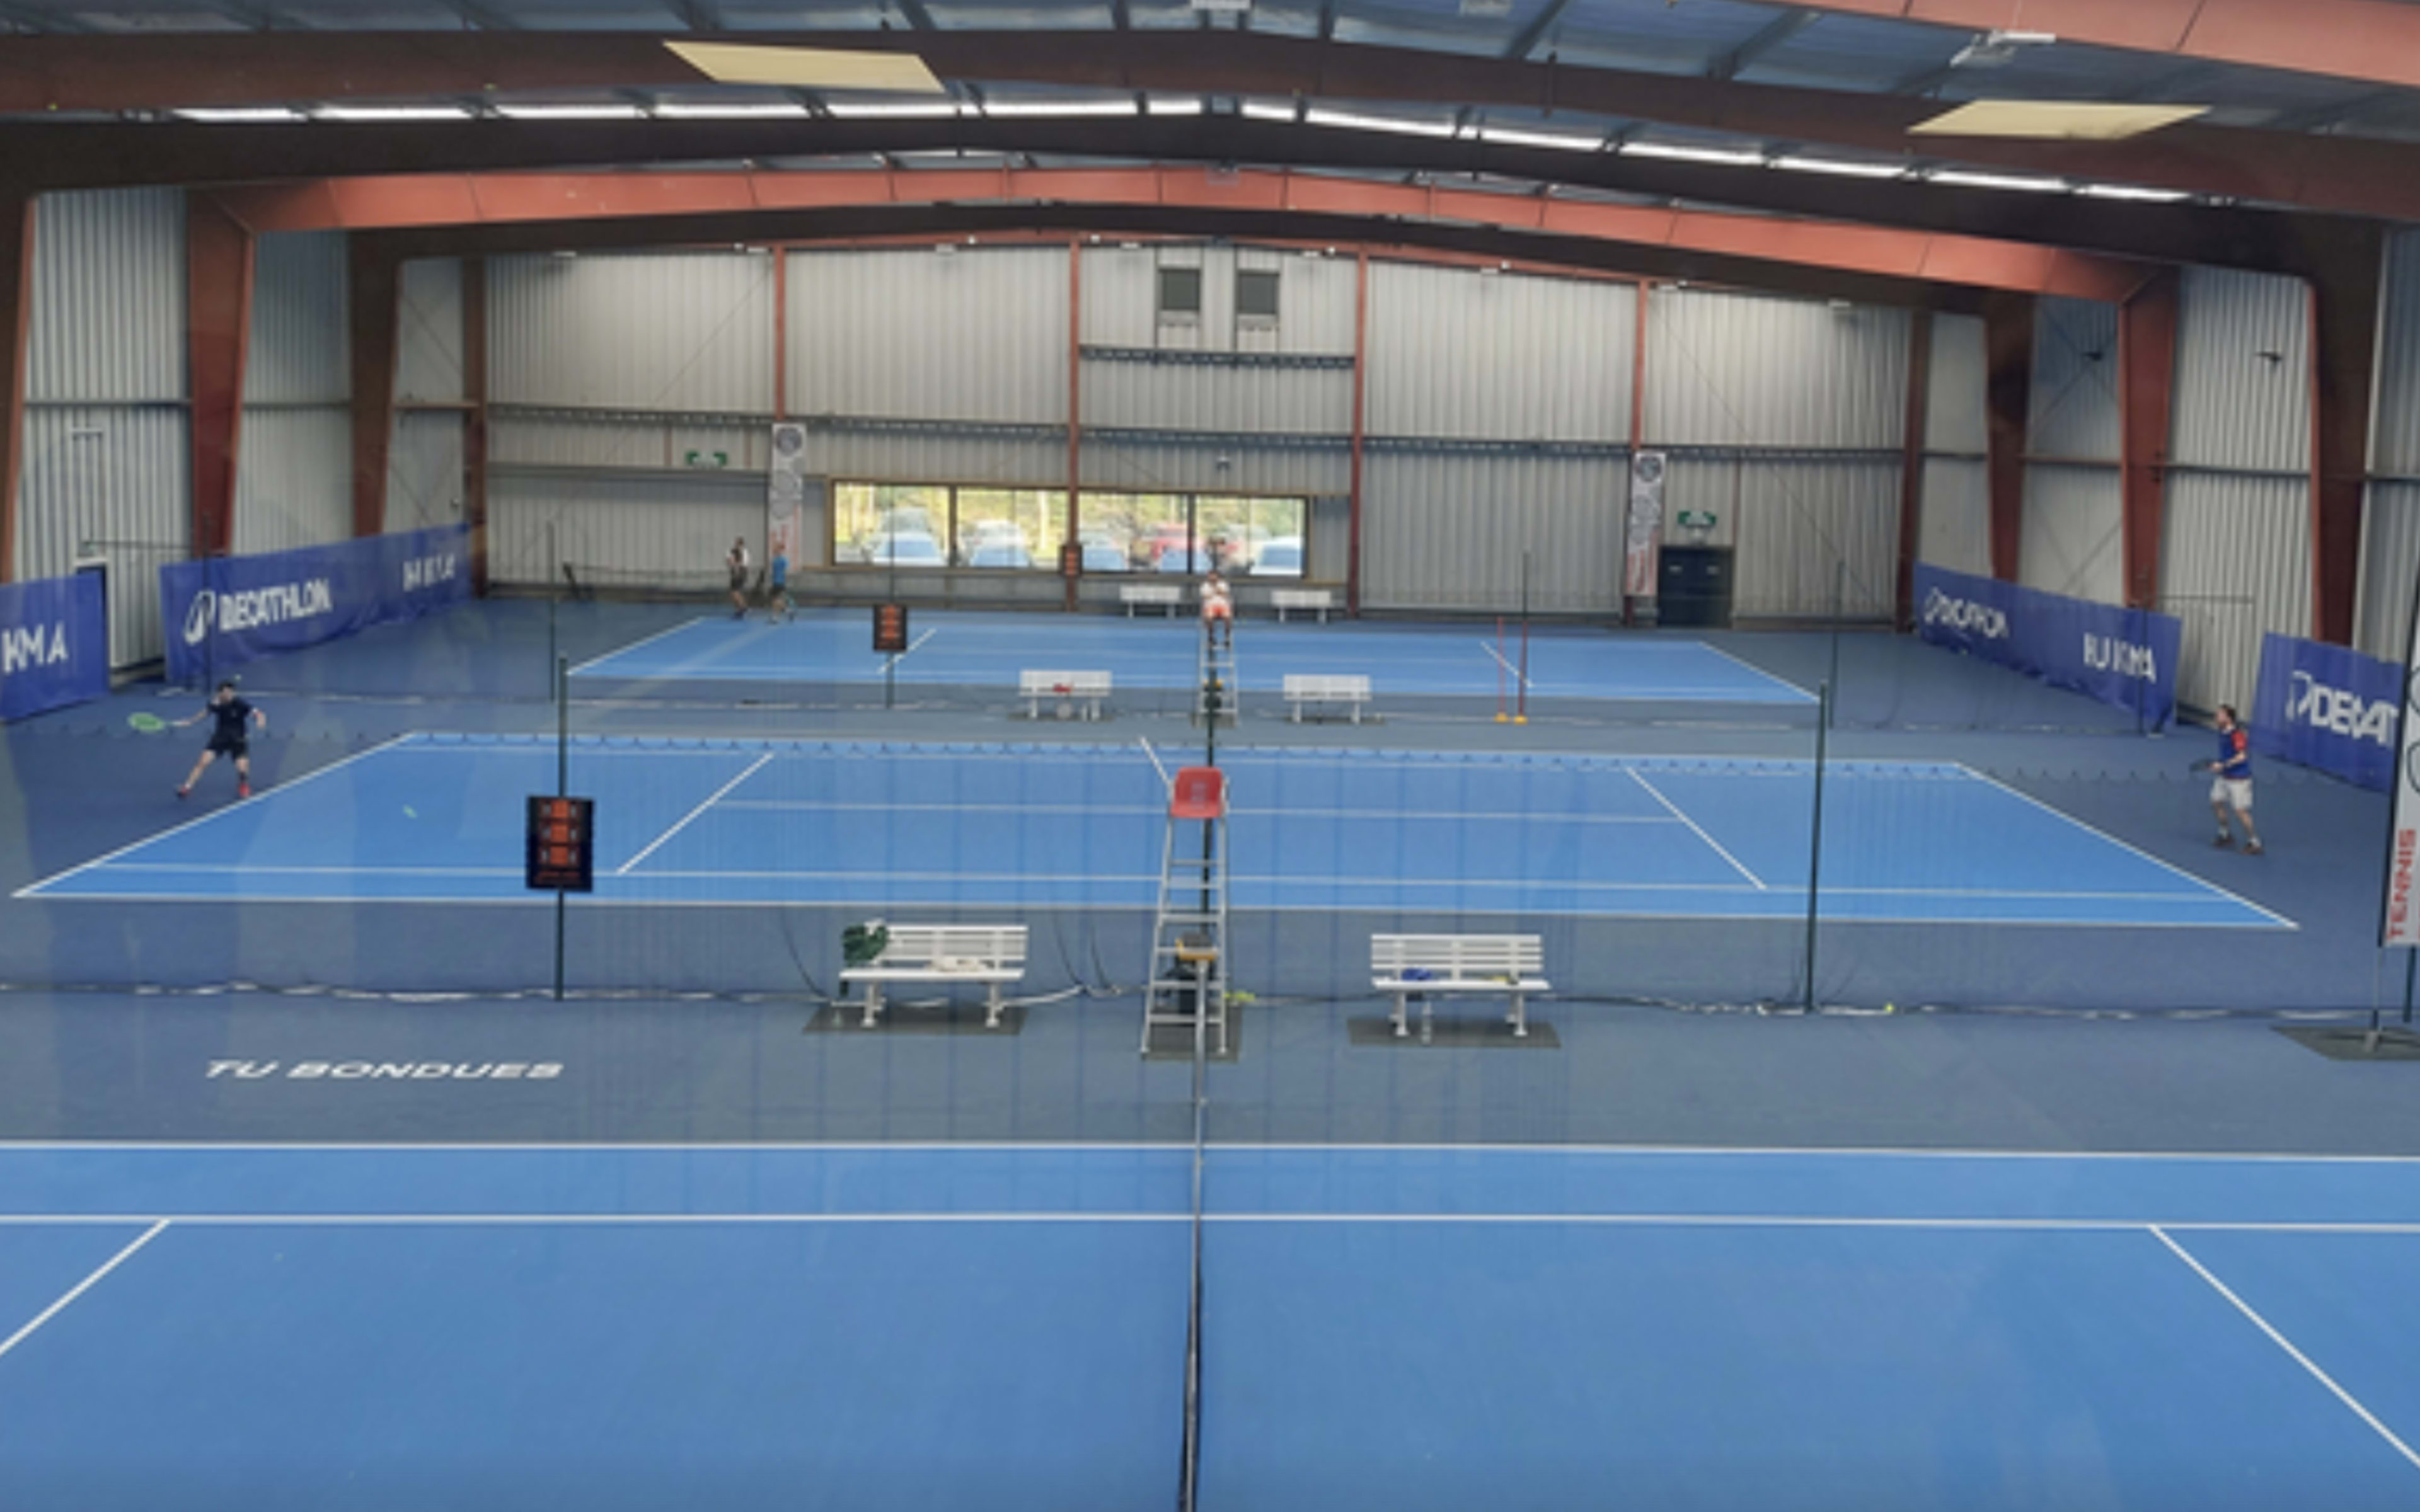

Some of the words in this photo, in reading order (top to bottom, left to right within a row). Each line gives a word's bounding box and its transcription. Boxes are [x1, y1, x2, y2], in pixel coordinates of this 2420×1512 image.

[219, 578, 332, 631] DECATHLON
[2388, 828, 2416, 941] TENNIS
[206, 1059, 279, 1078] TU
[287, 1062, 563, 1079] BONDUES
